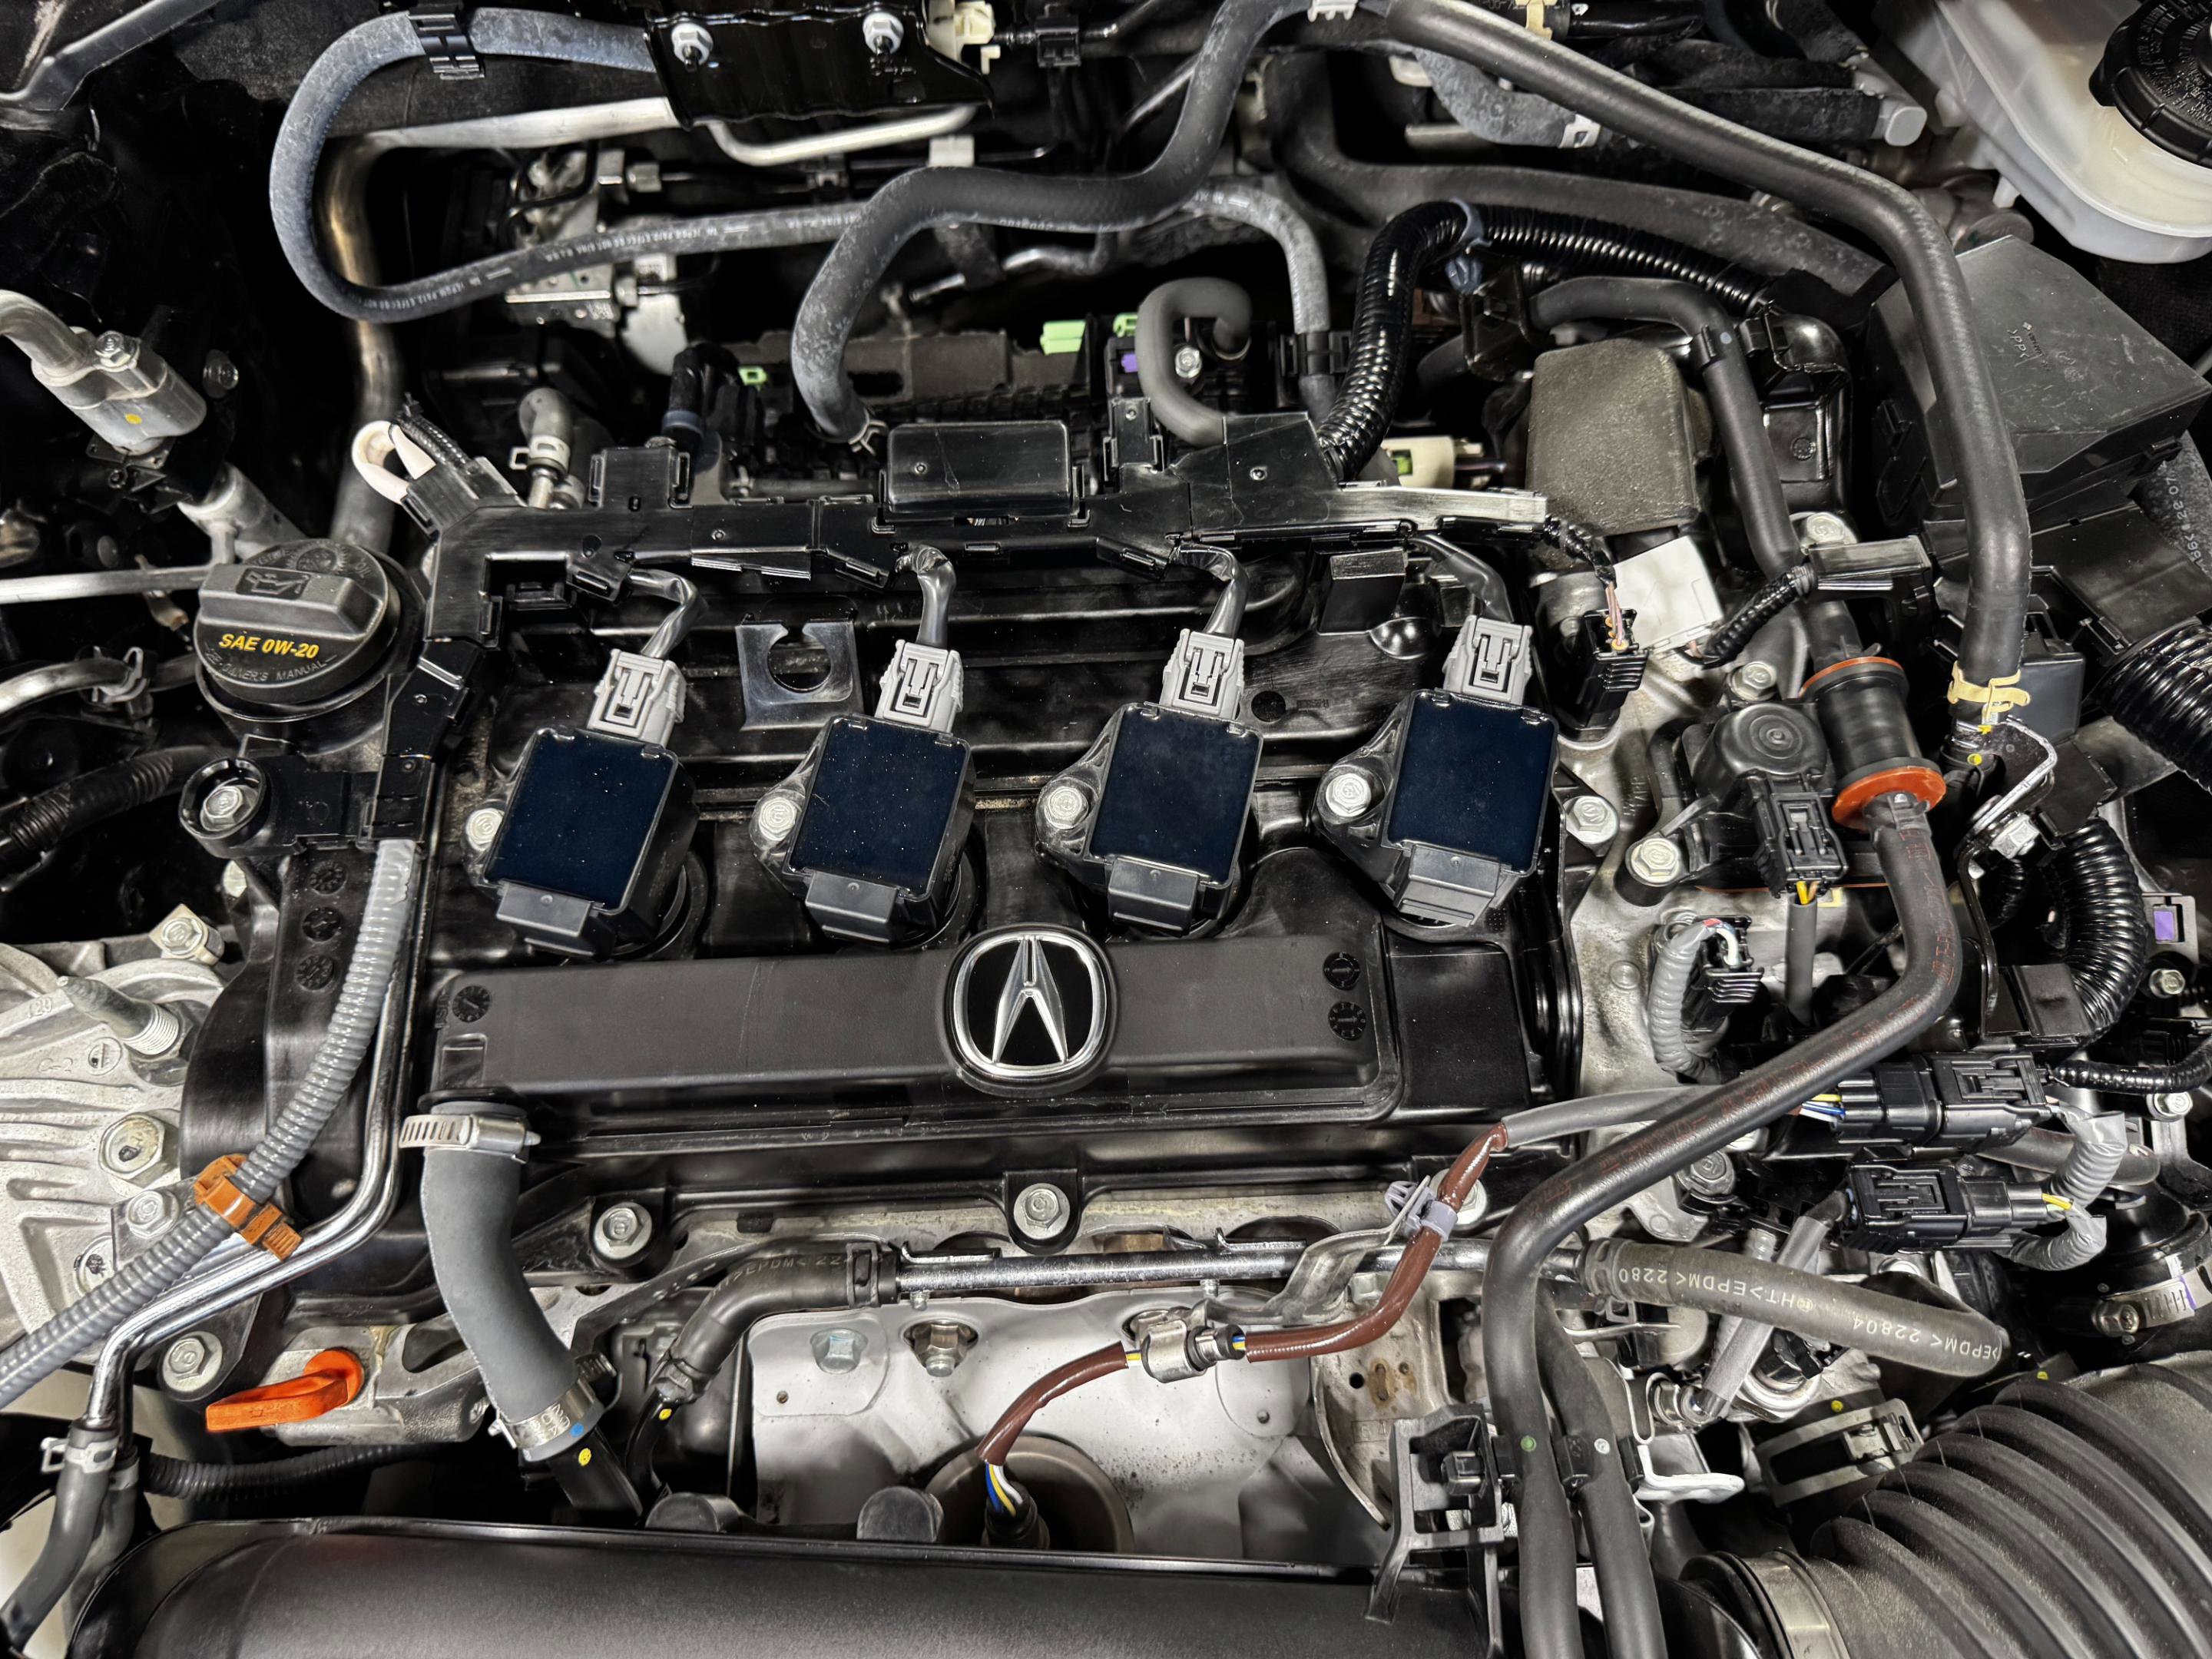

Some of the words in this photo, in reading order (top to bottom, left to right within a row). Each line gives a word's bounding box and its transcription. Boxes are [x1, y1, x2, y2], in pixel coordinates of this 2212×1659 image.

[218, 633, 261, 651] SAE
[262, 638, 320, 659] 0W-20
[276, 659, 327, 681] MANUAL
[1852, 1315, 1921, 1343] 22804
